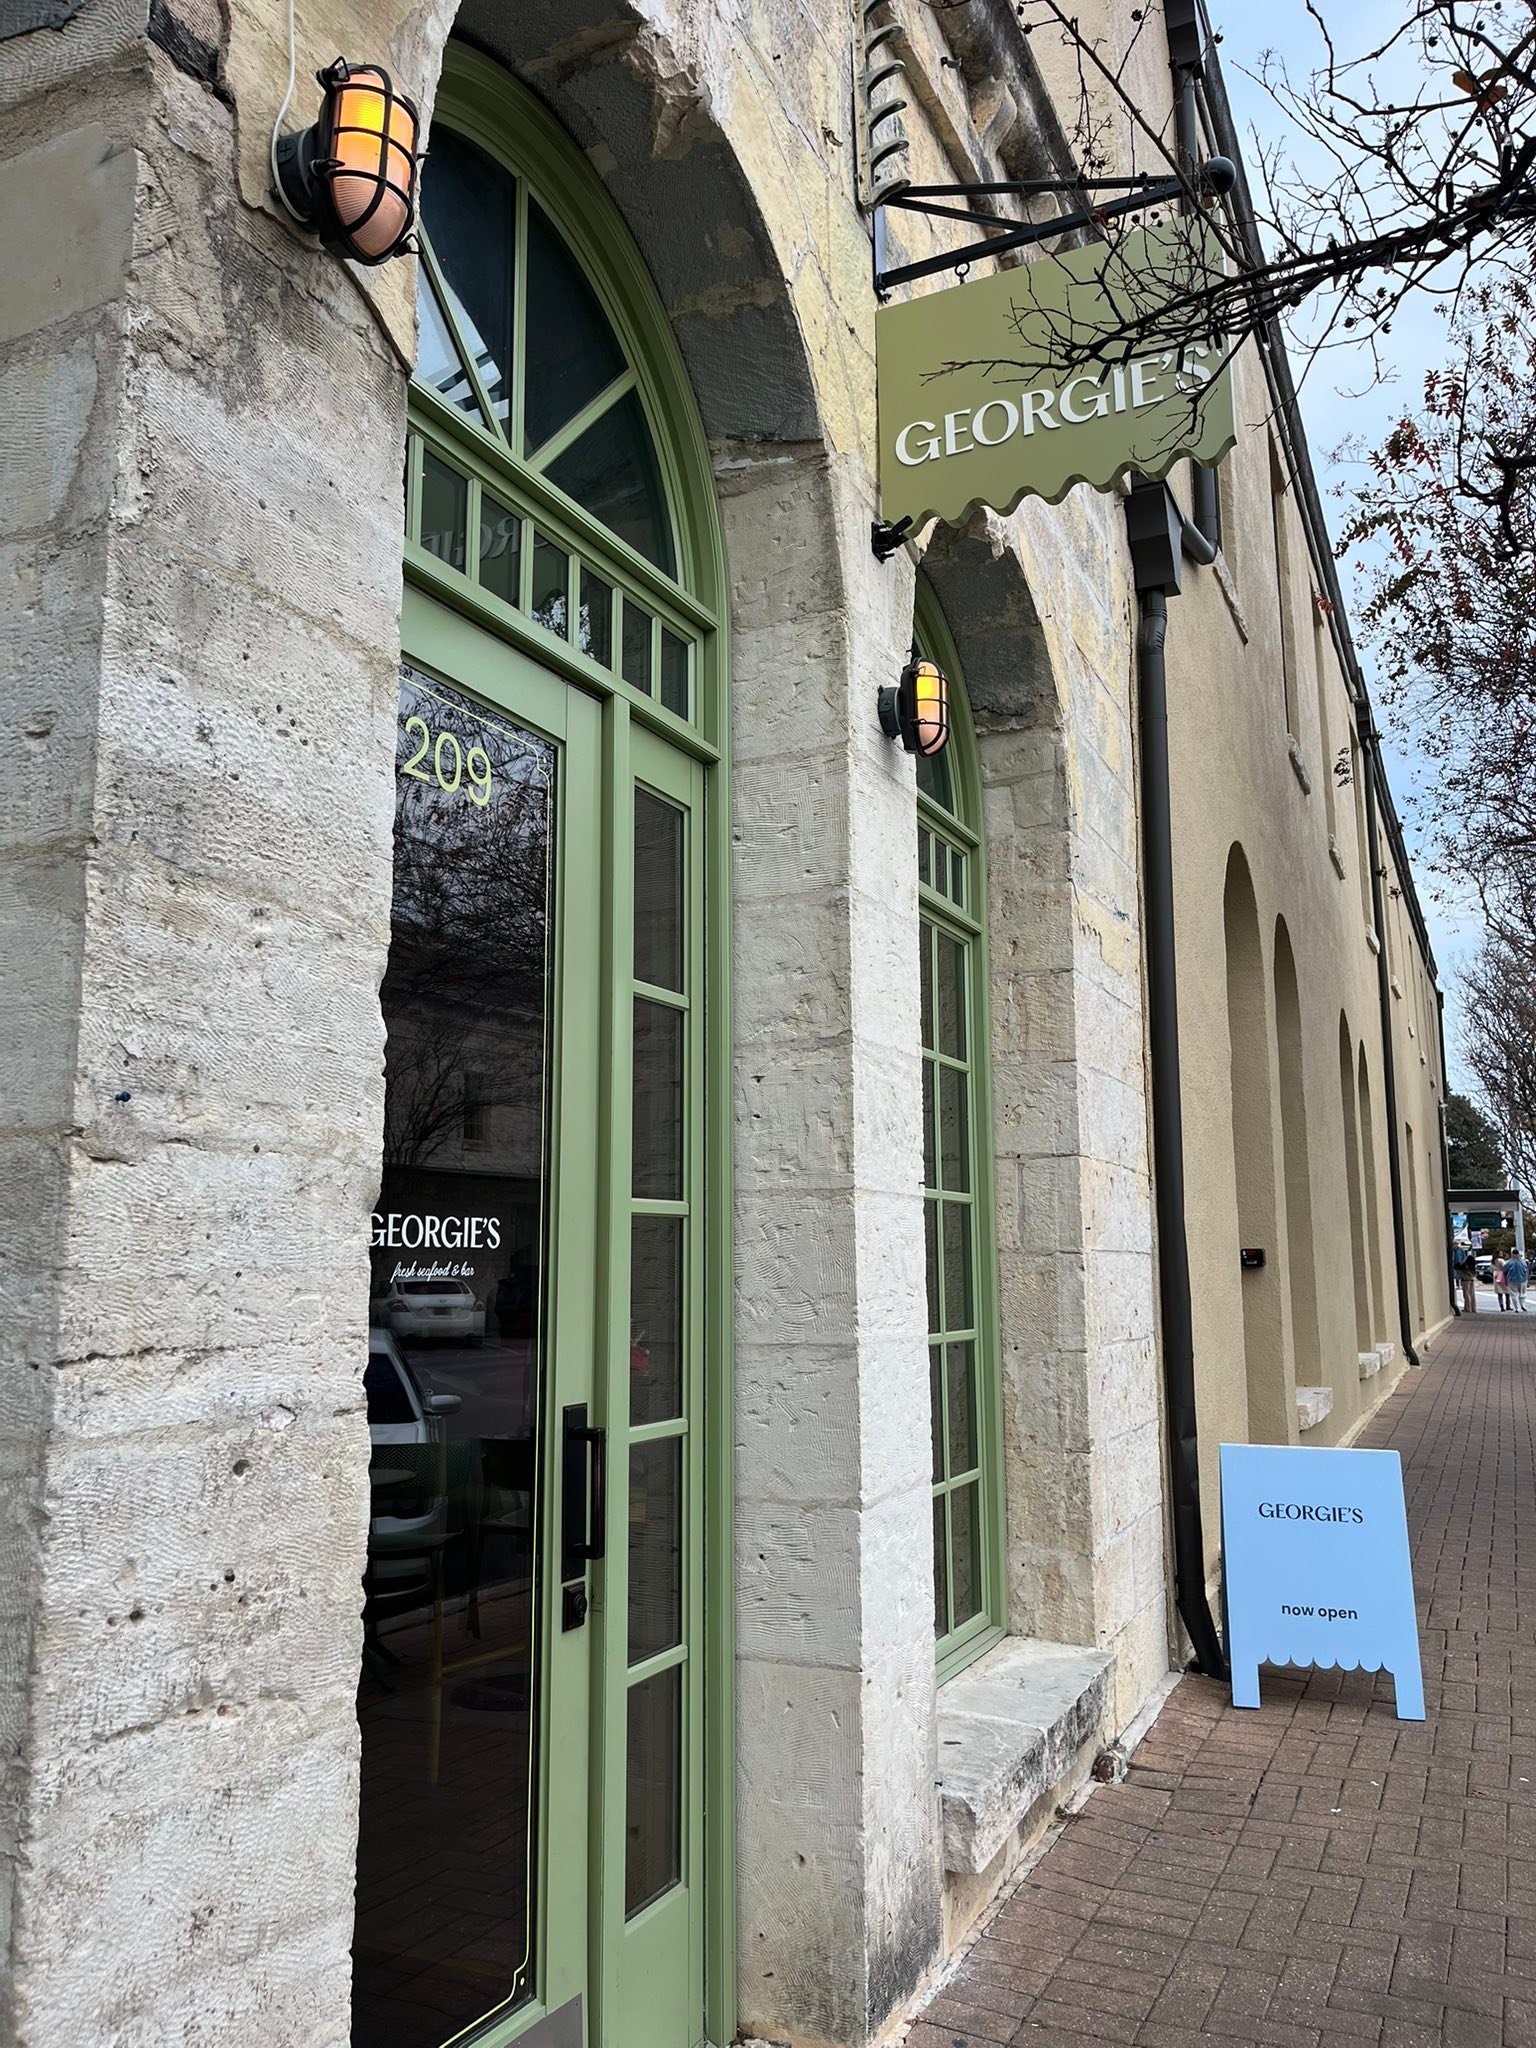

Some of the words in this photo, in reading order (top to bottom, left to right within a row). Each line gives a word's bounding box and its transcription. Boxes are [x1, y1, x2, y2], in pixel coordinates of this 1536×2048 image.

[895, 346, 1213, 467] GEORGIE'S
[404, 716, 492, 806] 209
[369, 1212, 501, 1250] GEORGIE'S
[390, 1260, 417, 1283] fresh
[417, 1260, 452, 1282] seafood
[452, 1264, 460, 1277] &
[461, 1261, 475, 1277] bar
[1258, 1502, 1364, 1524] GEORGIE'S
[1281, 1604, 1314, 1617] now
[1318, 1607, 1358, 1621] open
